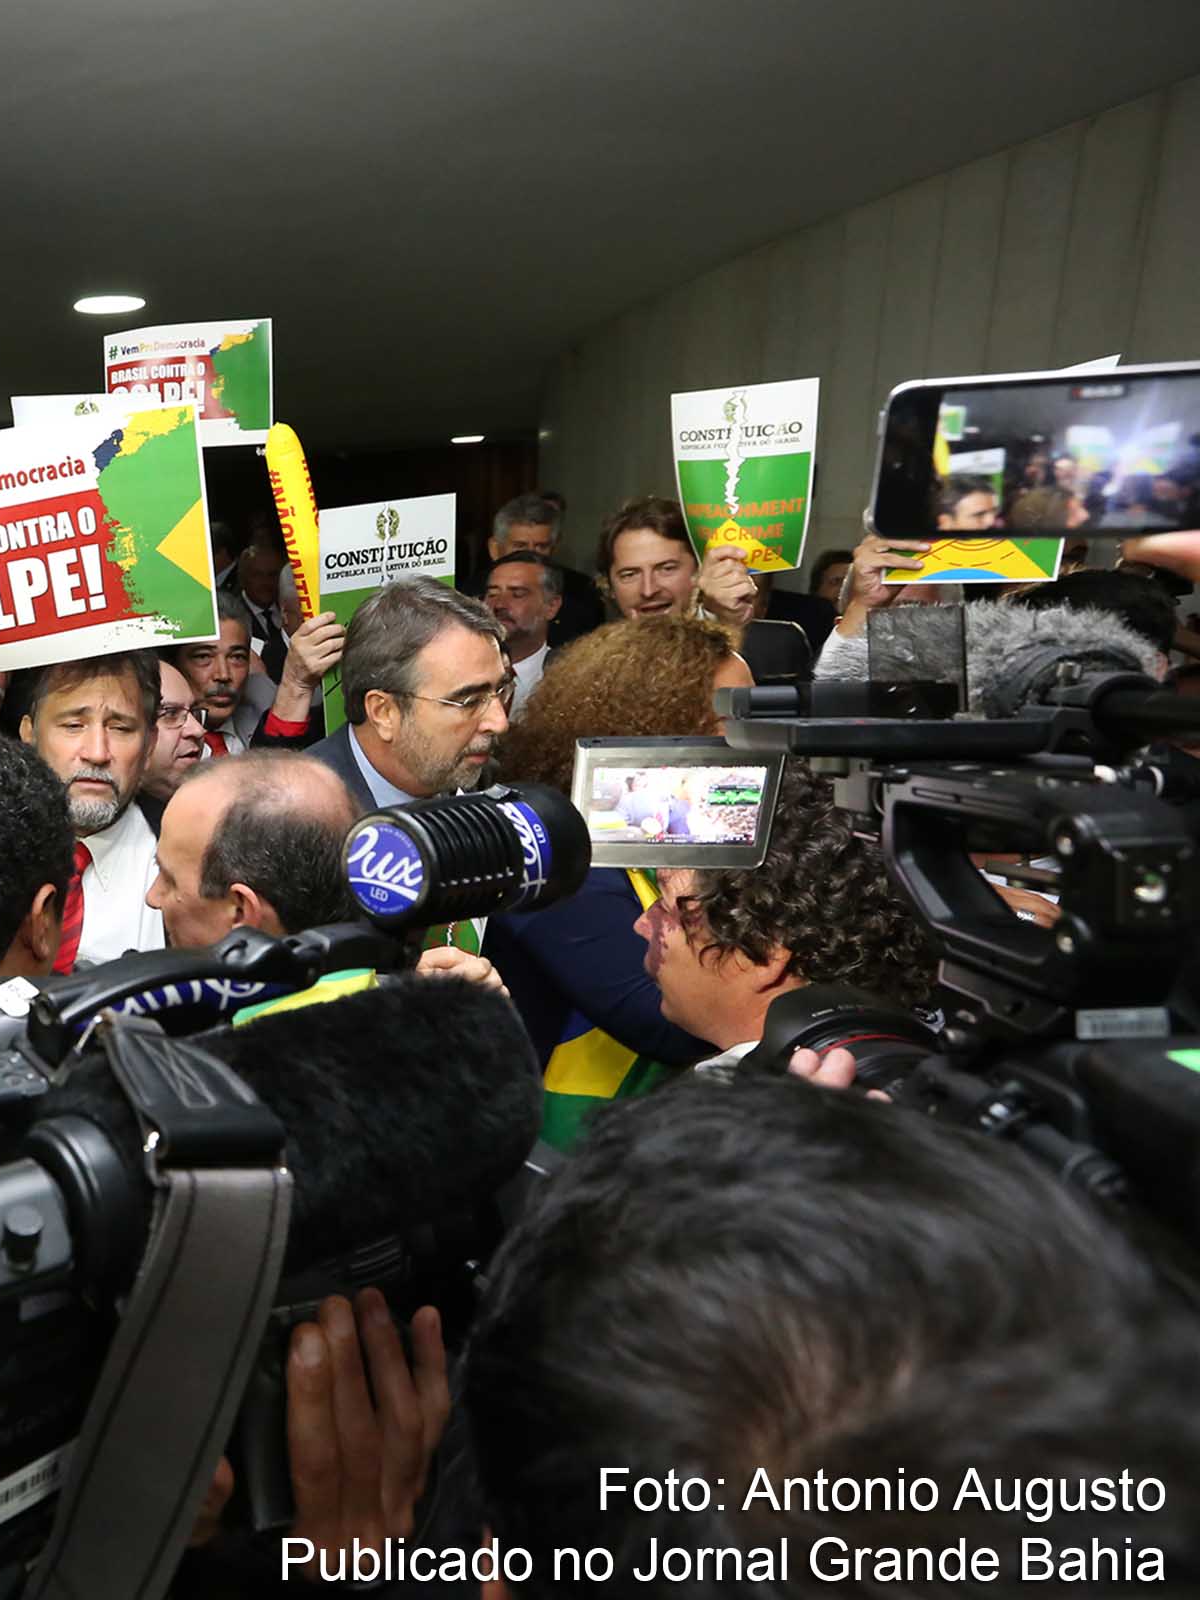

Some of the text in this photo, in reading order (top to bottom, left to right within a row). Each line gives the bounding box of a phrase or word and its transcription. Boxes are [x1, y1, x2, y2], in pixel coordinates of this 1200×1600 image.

[111, 366, 150, 385] BRASIL
[197, 362, 206, 377] O
[77, 506, 97, 536] O
[325, 537, 448, 569] CONSTITUIÇÃO
[370, 886, 389, 902] LED
